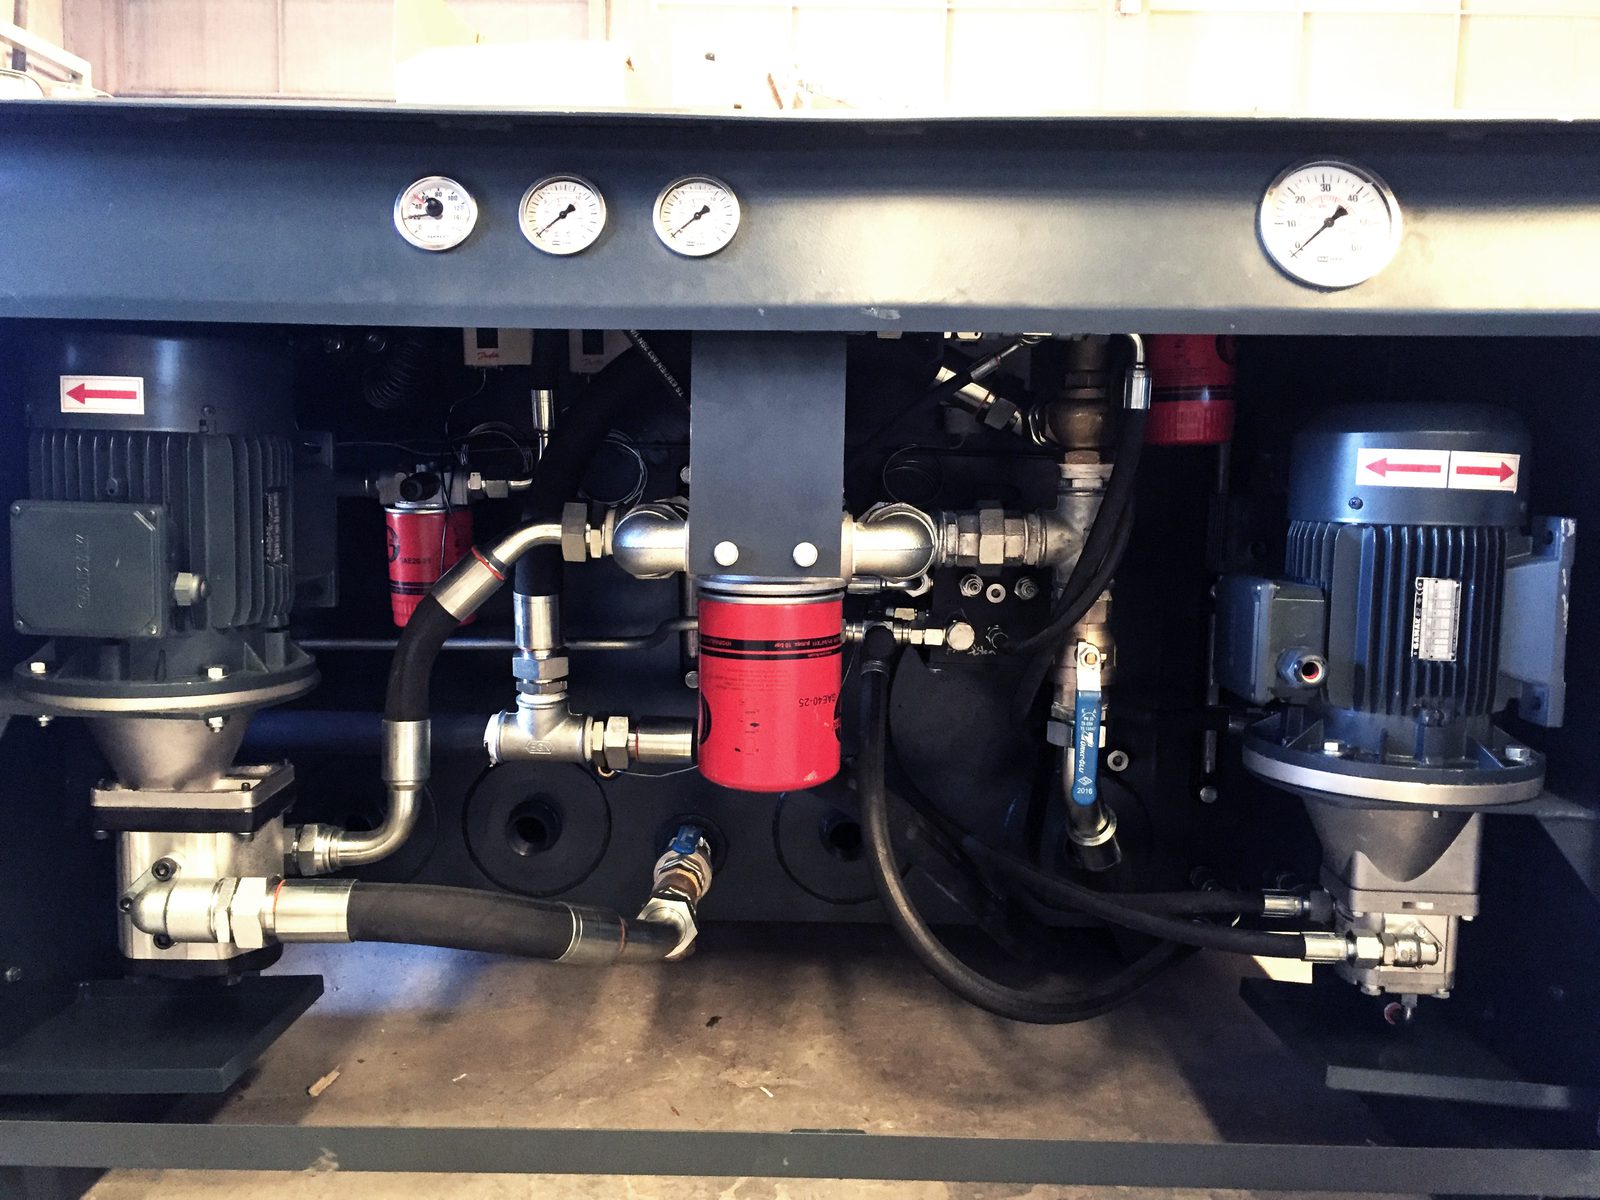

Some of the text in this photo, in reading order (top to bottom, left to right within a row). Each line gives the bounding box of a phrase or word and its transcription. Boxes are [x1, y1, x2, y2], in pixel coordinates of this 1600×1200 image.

[1320, 184, 1331, 192] 30
[1295, 196, 1306, 204] 20
[1348, 194, 1358, 202] 40
